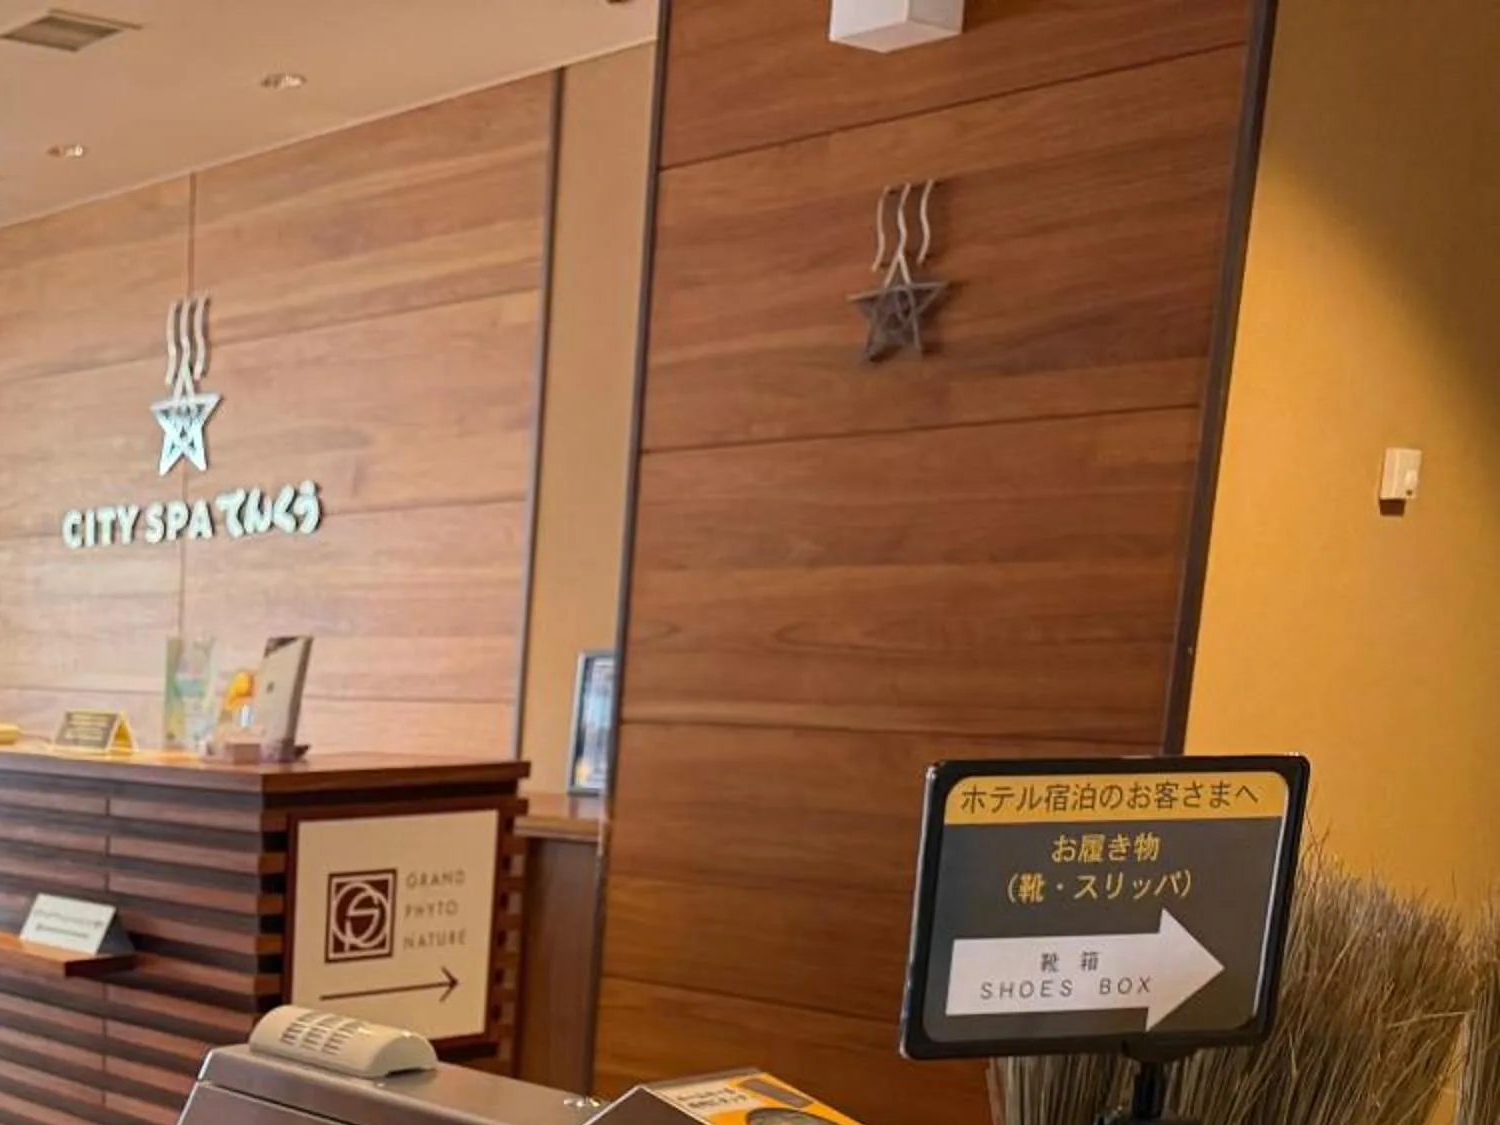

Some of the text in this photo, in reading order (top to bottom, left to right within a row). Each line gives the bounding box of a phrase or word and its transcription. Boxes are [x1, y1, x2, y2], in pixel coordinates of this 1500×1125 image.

[62, 480, 323, 549] CITY SPA てんくう
[960, 780, 1259, 815] ホテル宿泊のお客さまへ
[1052, 832, 1160, 864] お履き物
[406, 868, 466, 890] GRAND
[404, 899, 458, 919] PHYTO
[403, 929, 467, 950] NATURE
[979, 976, 1151, 1001] SHOES BOX
